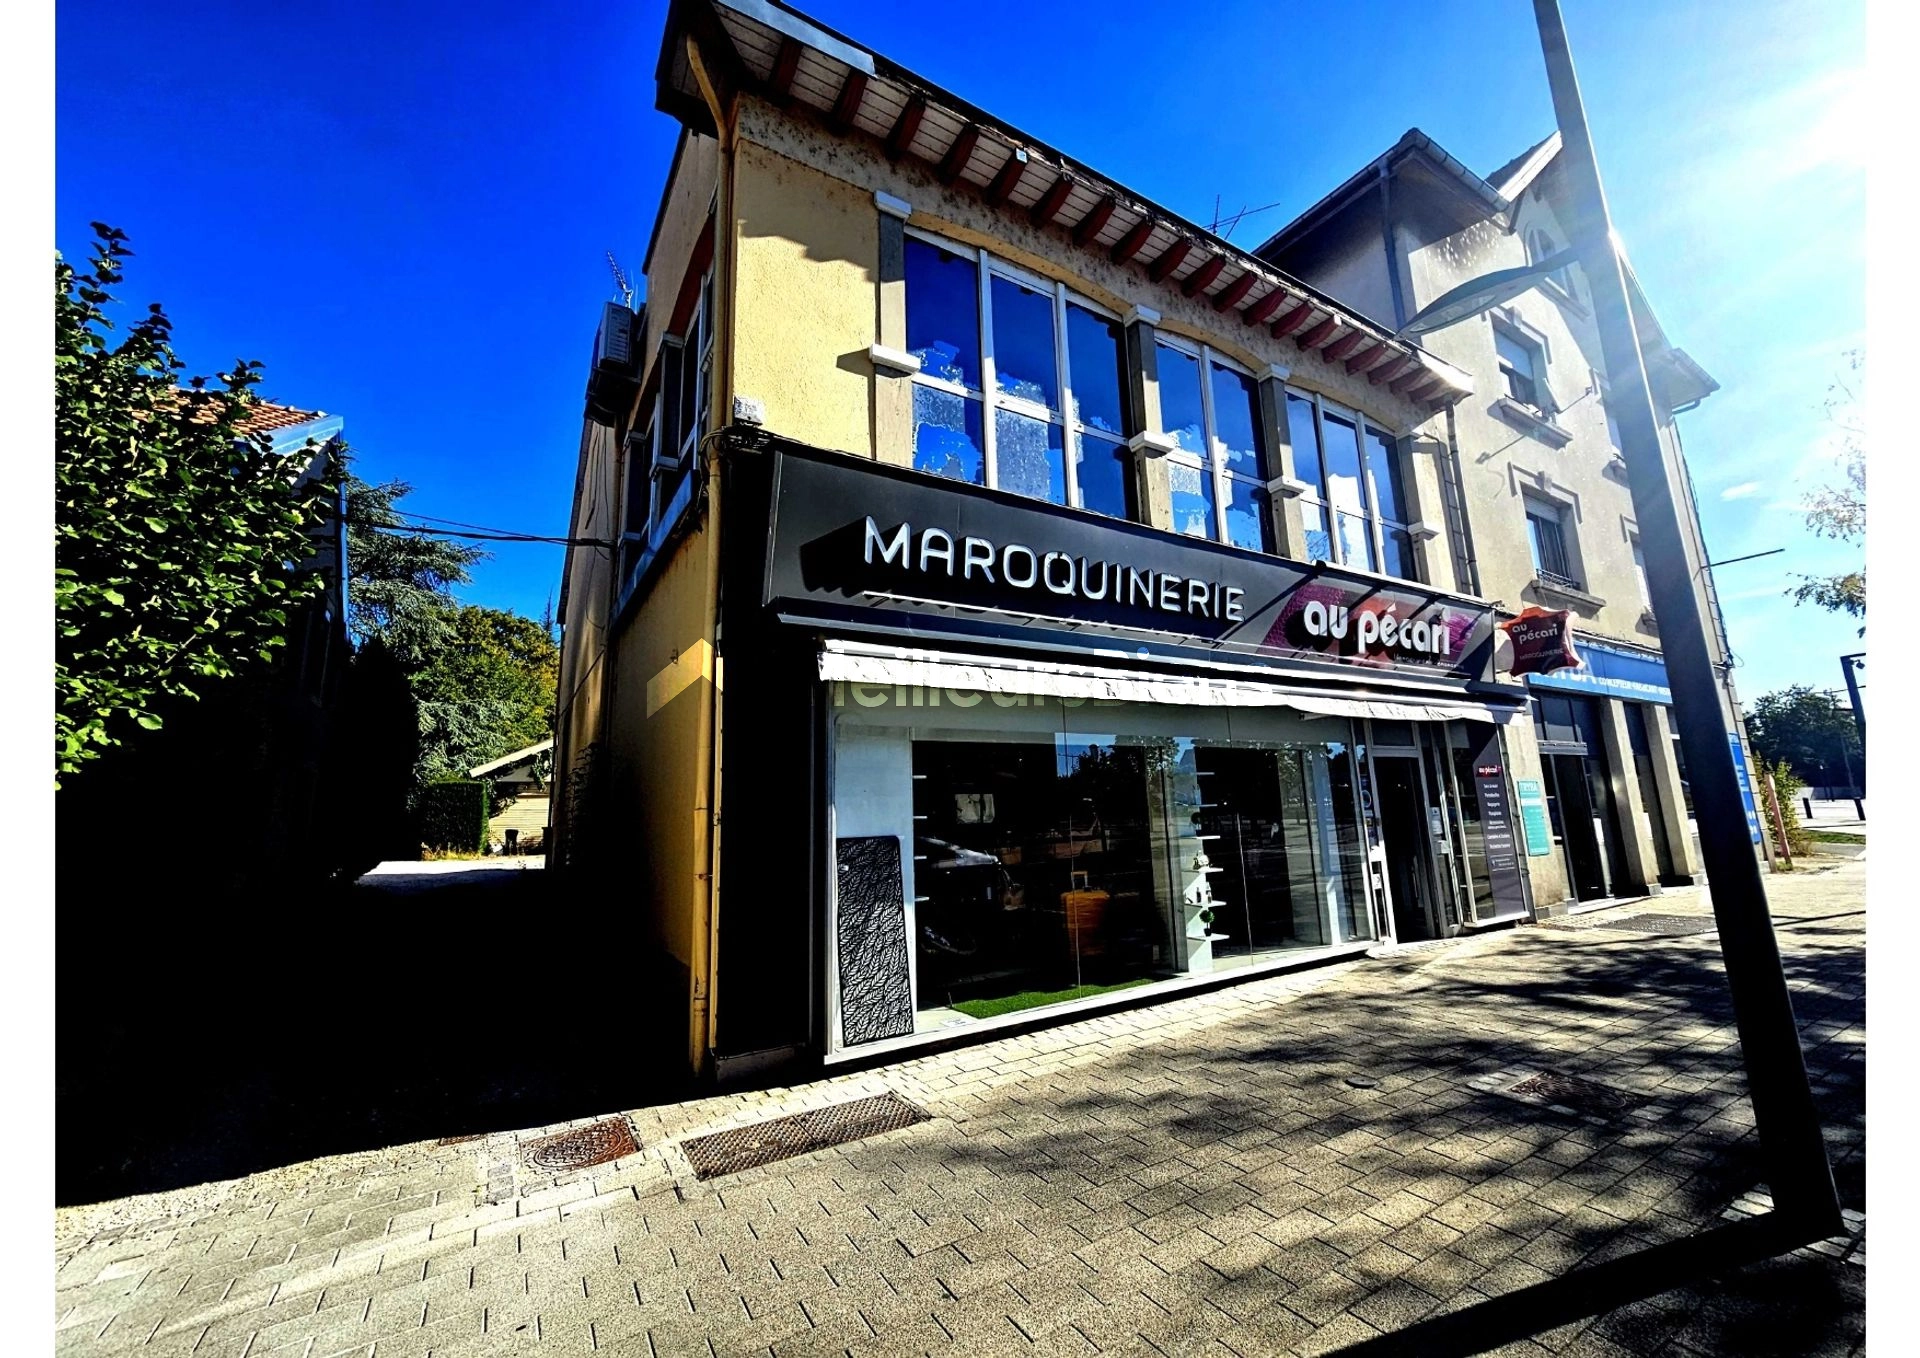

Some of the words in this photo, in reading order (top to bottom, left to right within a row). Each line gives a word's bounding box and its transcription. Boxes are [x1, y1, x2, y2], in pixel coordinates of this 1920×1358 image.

[863, 514, 1247, 623] MAROQUINERIE
[1303, 600, 1349, 640] au
[1357, 602, 1451, 655] pécari
[1511, 623, 1528, 634] au
[1519, 623, 1559, 645] pécari
